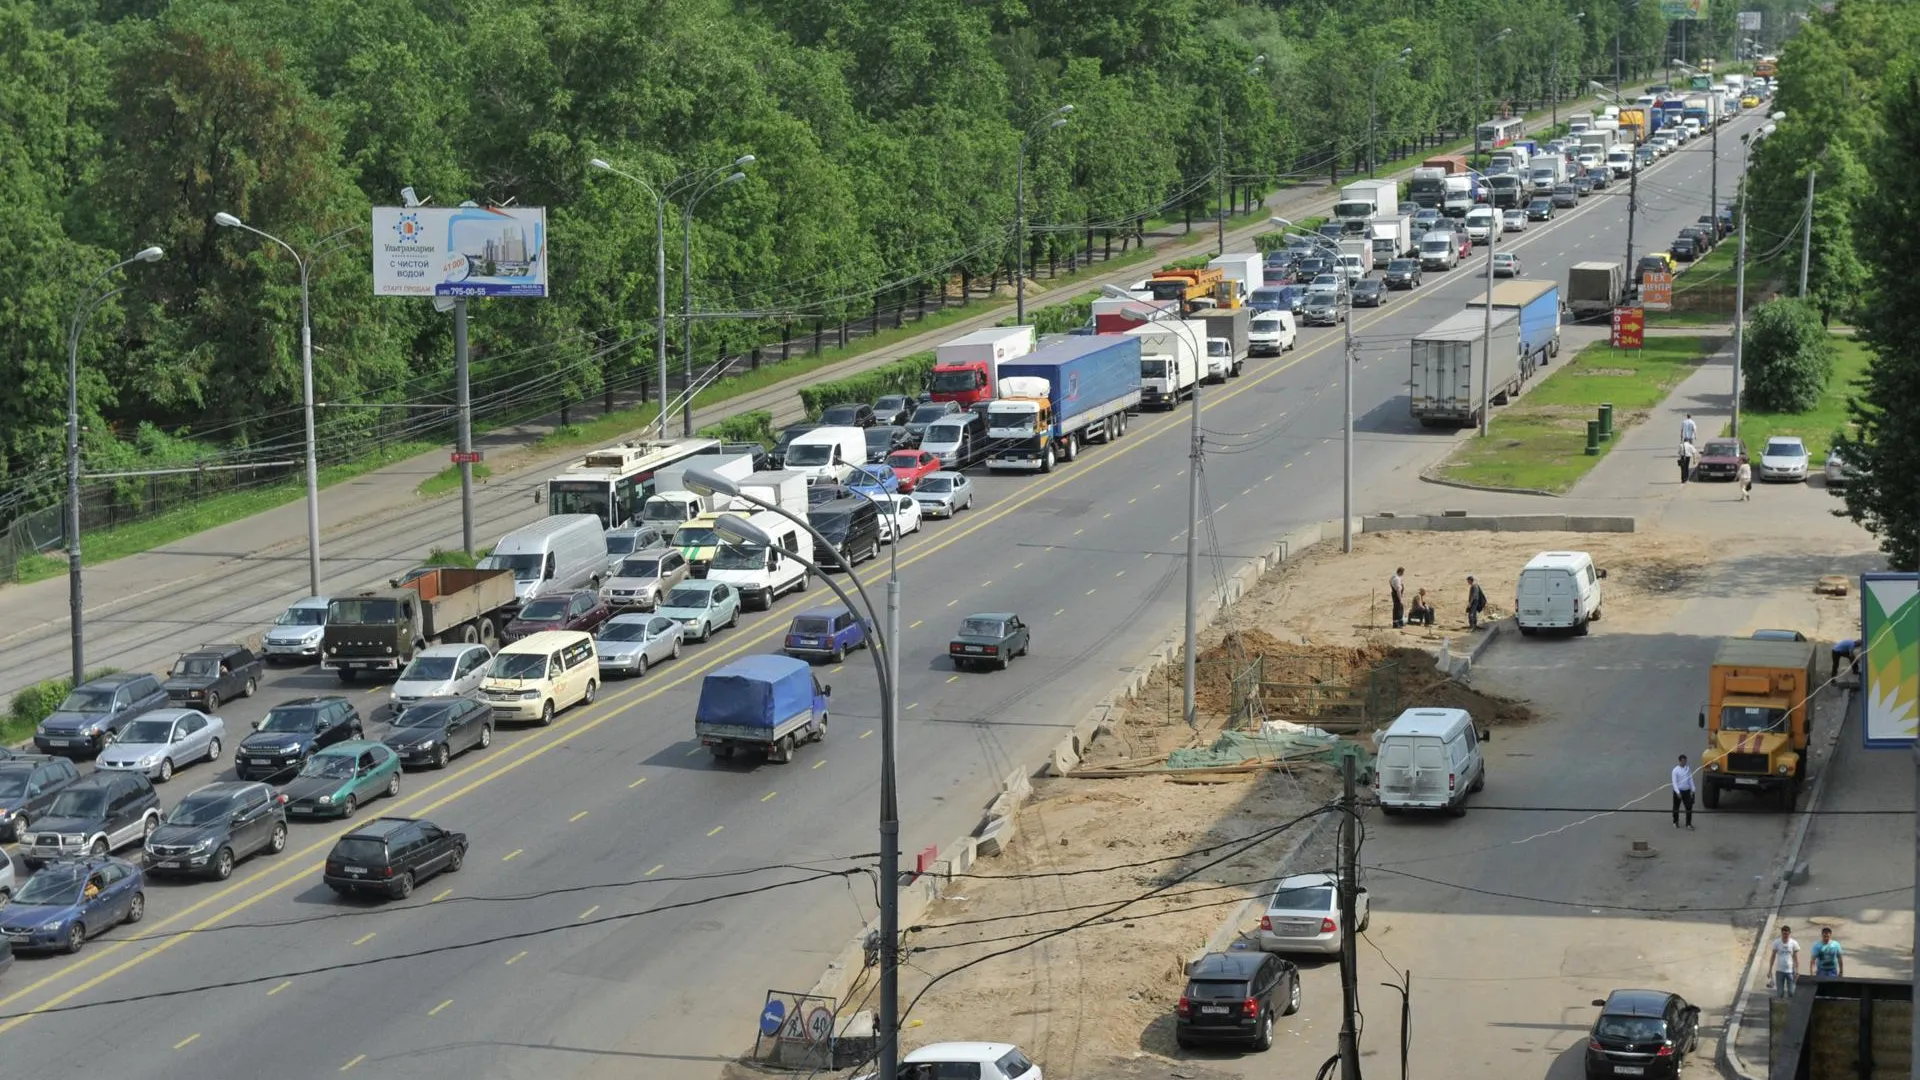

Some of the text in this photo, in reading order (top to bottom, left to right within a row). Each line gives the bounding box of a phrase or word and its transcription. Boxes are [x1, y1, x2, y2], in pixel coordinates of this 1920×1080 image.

[389, 259, 430, 268] С ЧИСТОЙ
[396, 269, 425, 278] ВОДОЙ
[450, 287, 486, 295] 795-00-55
[1613, 308, 1621, 347] МОЙКА
[812, 1016, 827, 1034] 40
